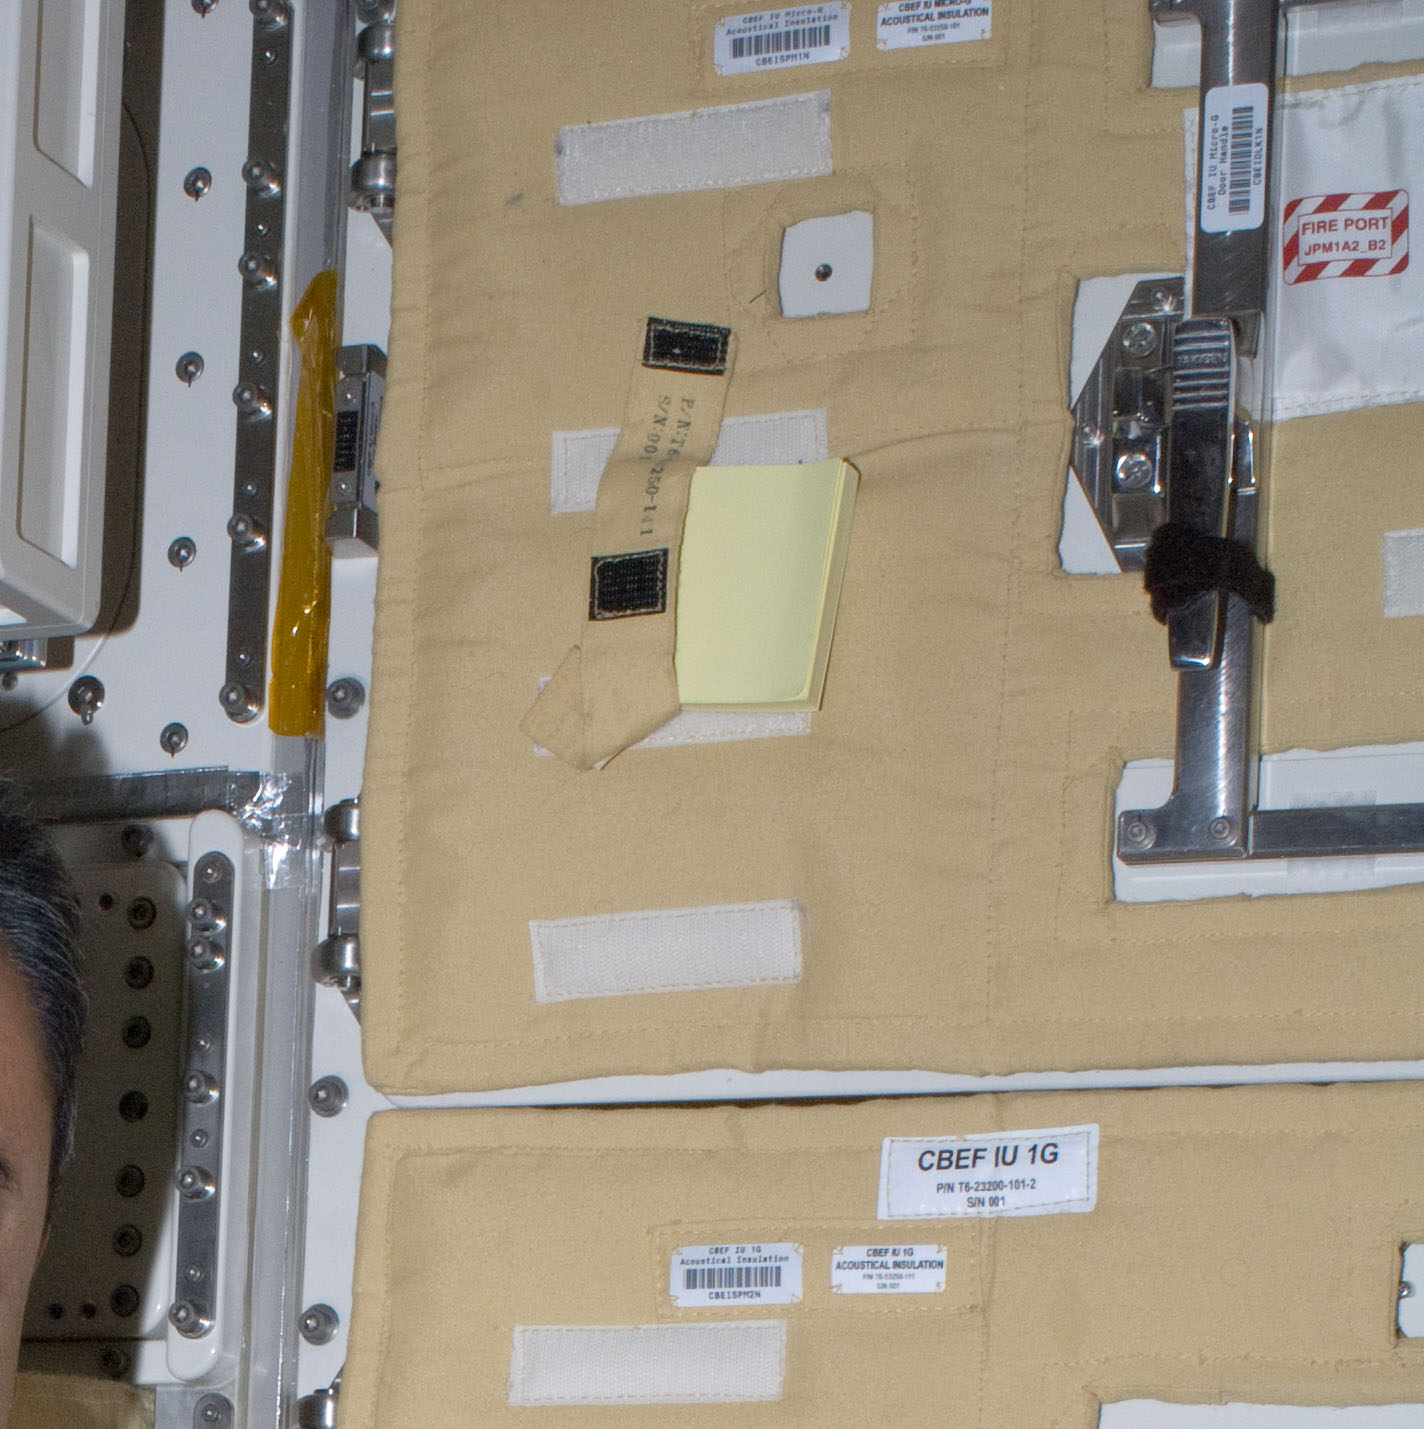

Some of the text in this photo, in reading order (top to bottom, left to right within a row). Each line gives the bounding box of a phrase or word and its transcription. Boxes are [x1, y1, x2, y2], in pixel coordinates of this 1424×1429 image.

[880, 6, 990, 27] ACOUSTICAL INSULATION
[1301, 216, 1390, 236] FIRE PORT
[1304, 239, 1387, 257] JPM1A2_B2
[918, 1142, 1059, 1172] CBEF IU 1G
[937, 1178, 1037, 1194] P/N T6-23200-101-2
[966, 1195, 1006, 1208] S/N 001
[834, 1259, 945, 1272] ACOUSTICAL INSULATION
